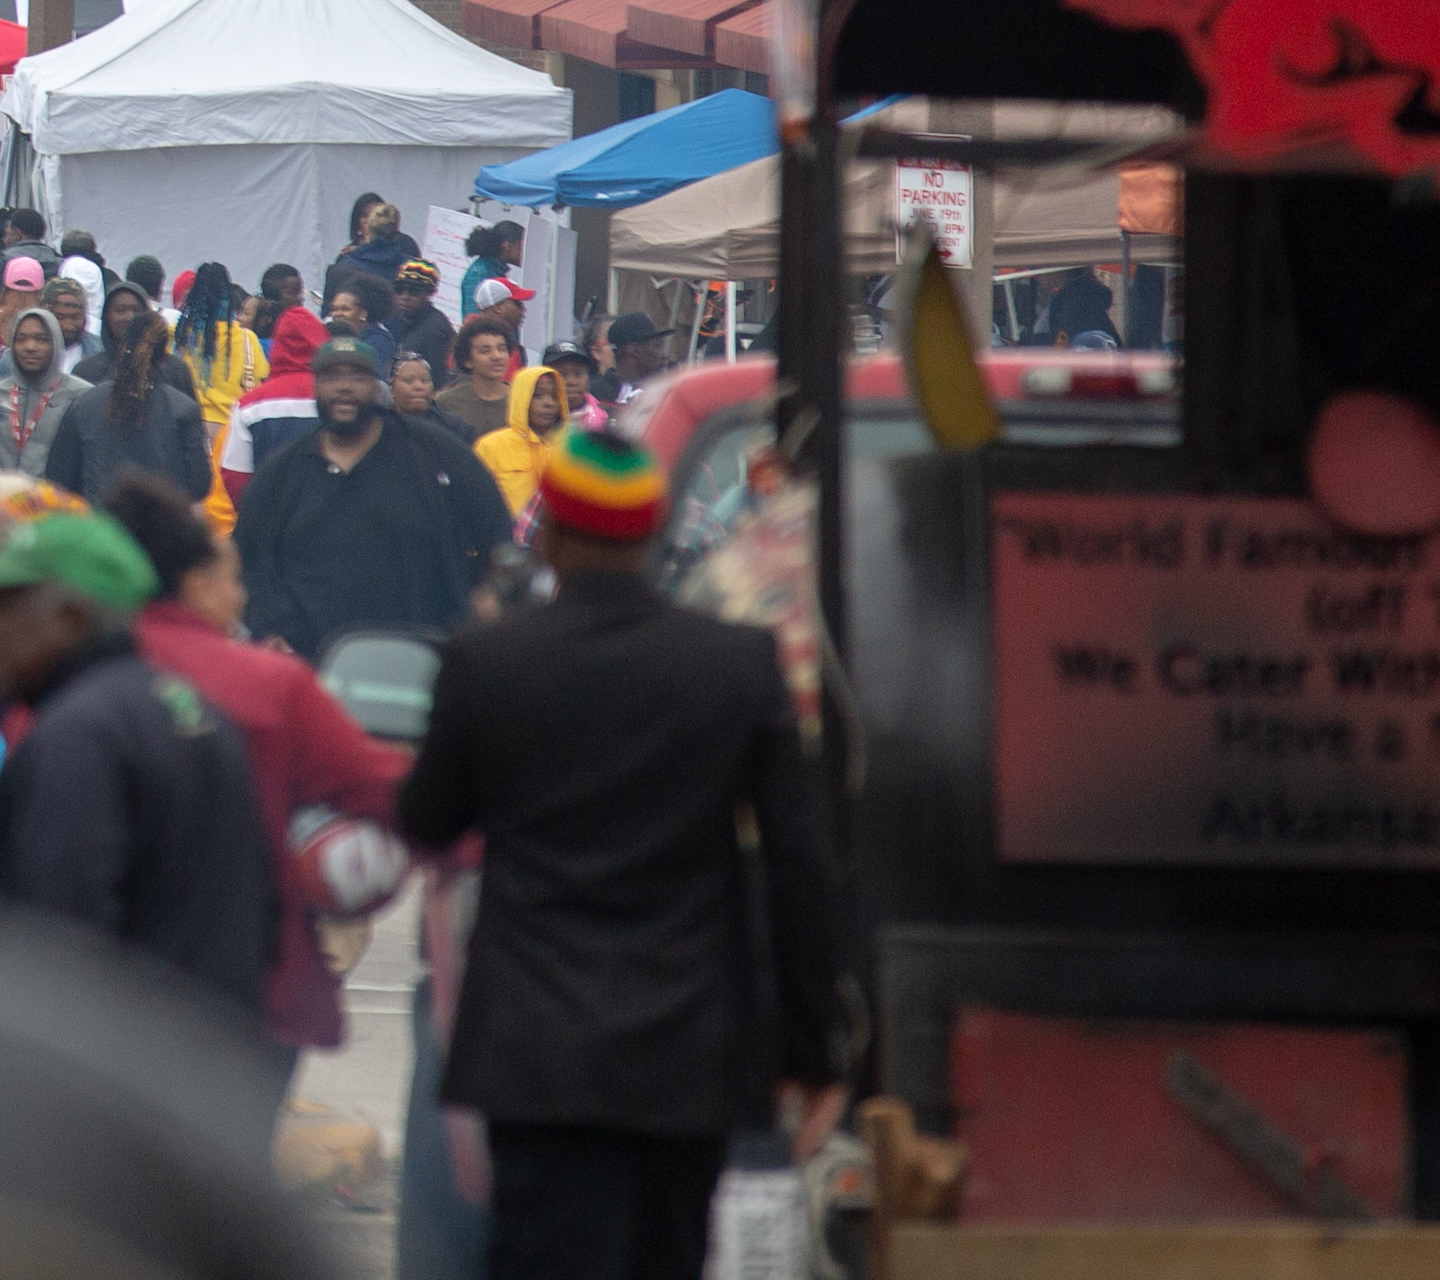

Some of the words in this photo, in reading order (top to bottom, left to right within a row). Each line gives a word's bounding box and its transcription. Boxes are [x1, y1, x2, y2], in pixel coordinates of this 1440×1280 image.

[923, 171, 944, 189] NO
[901, 188, 967, 207] PARKING
[944, 223, 965, 235] 8PM
[1051, 642, 1140, 697] We
[1157, 641, 1313, 698] Cater
